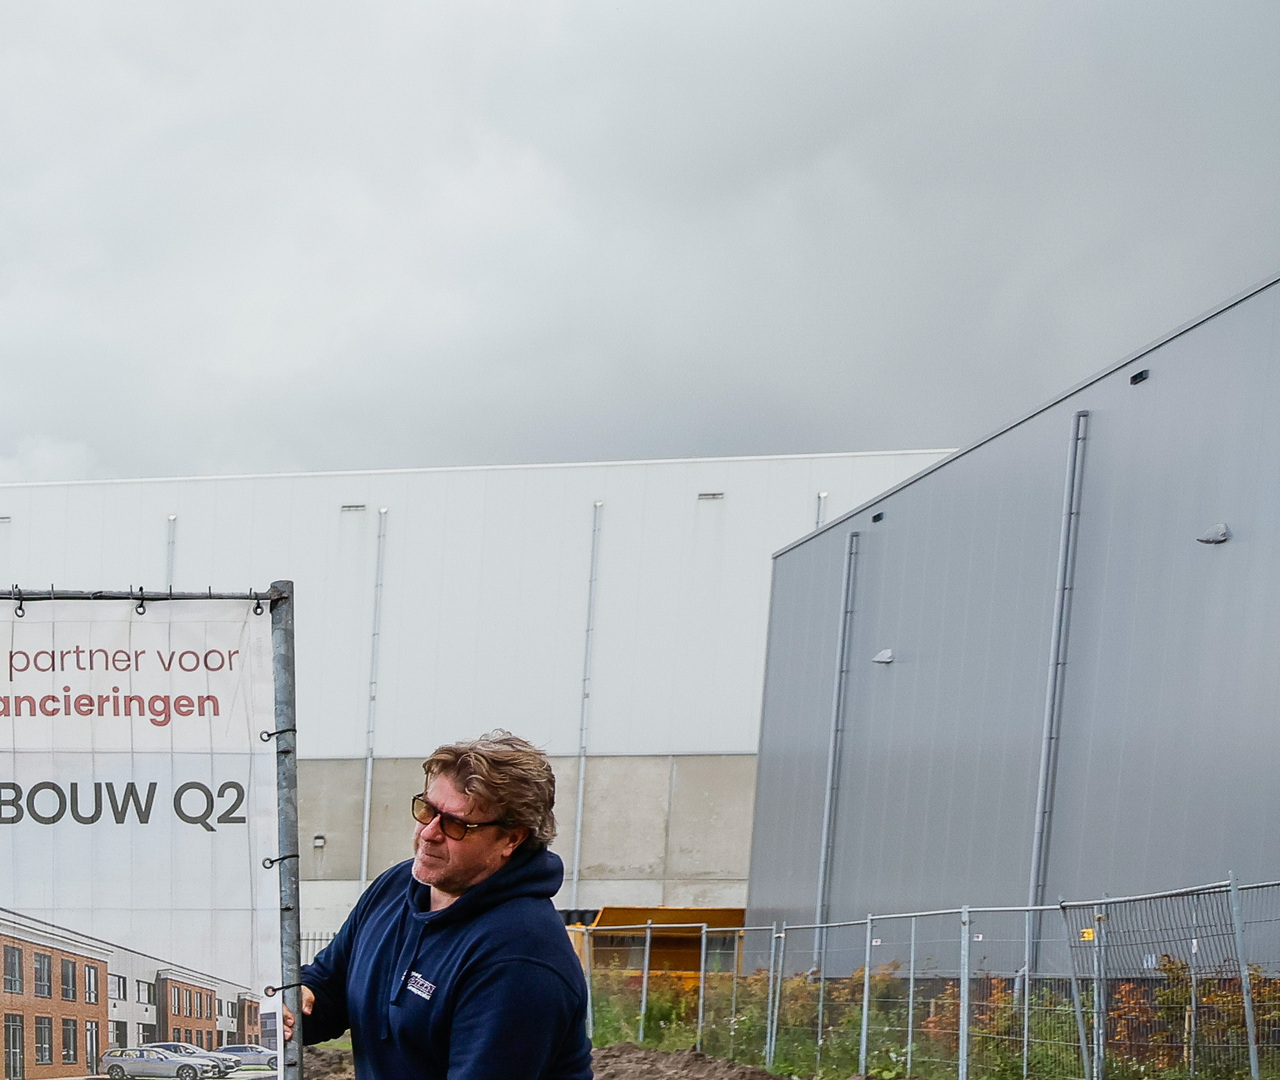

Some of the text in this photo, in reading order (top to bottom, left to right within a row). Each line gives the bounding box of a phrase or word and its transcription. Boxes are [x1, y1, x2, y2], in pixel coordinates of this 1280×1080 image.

[9, 645, 146, 682] partner
[157, 649, 240, 673] voor
[173, 781, 246, 832] Q2
